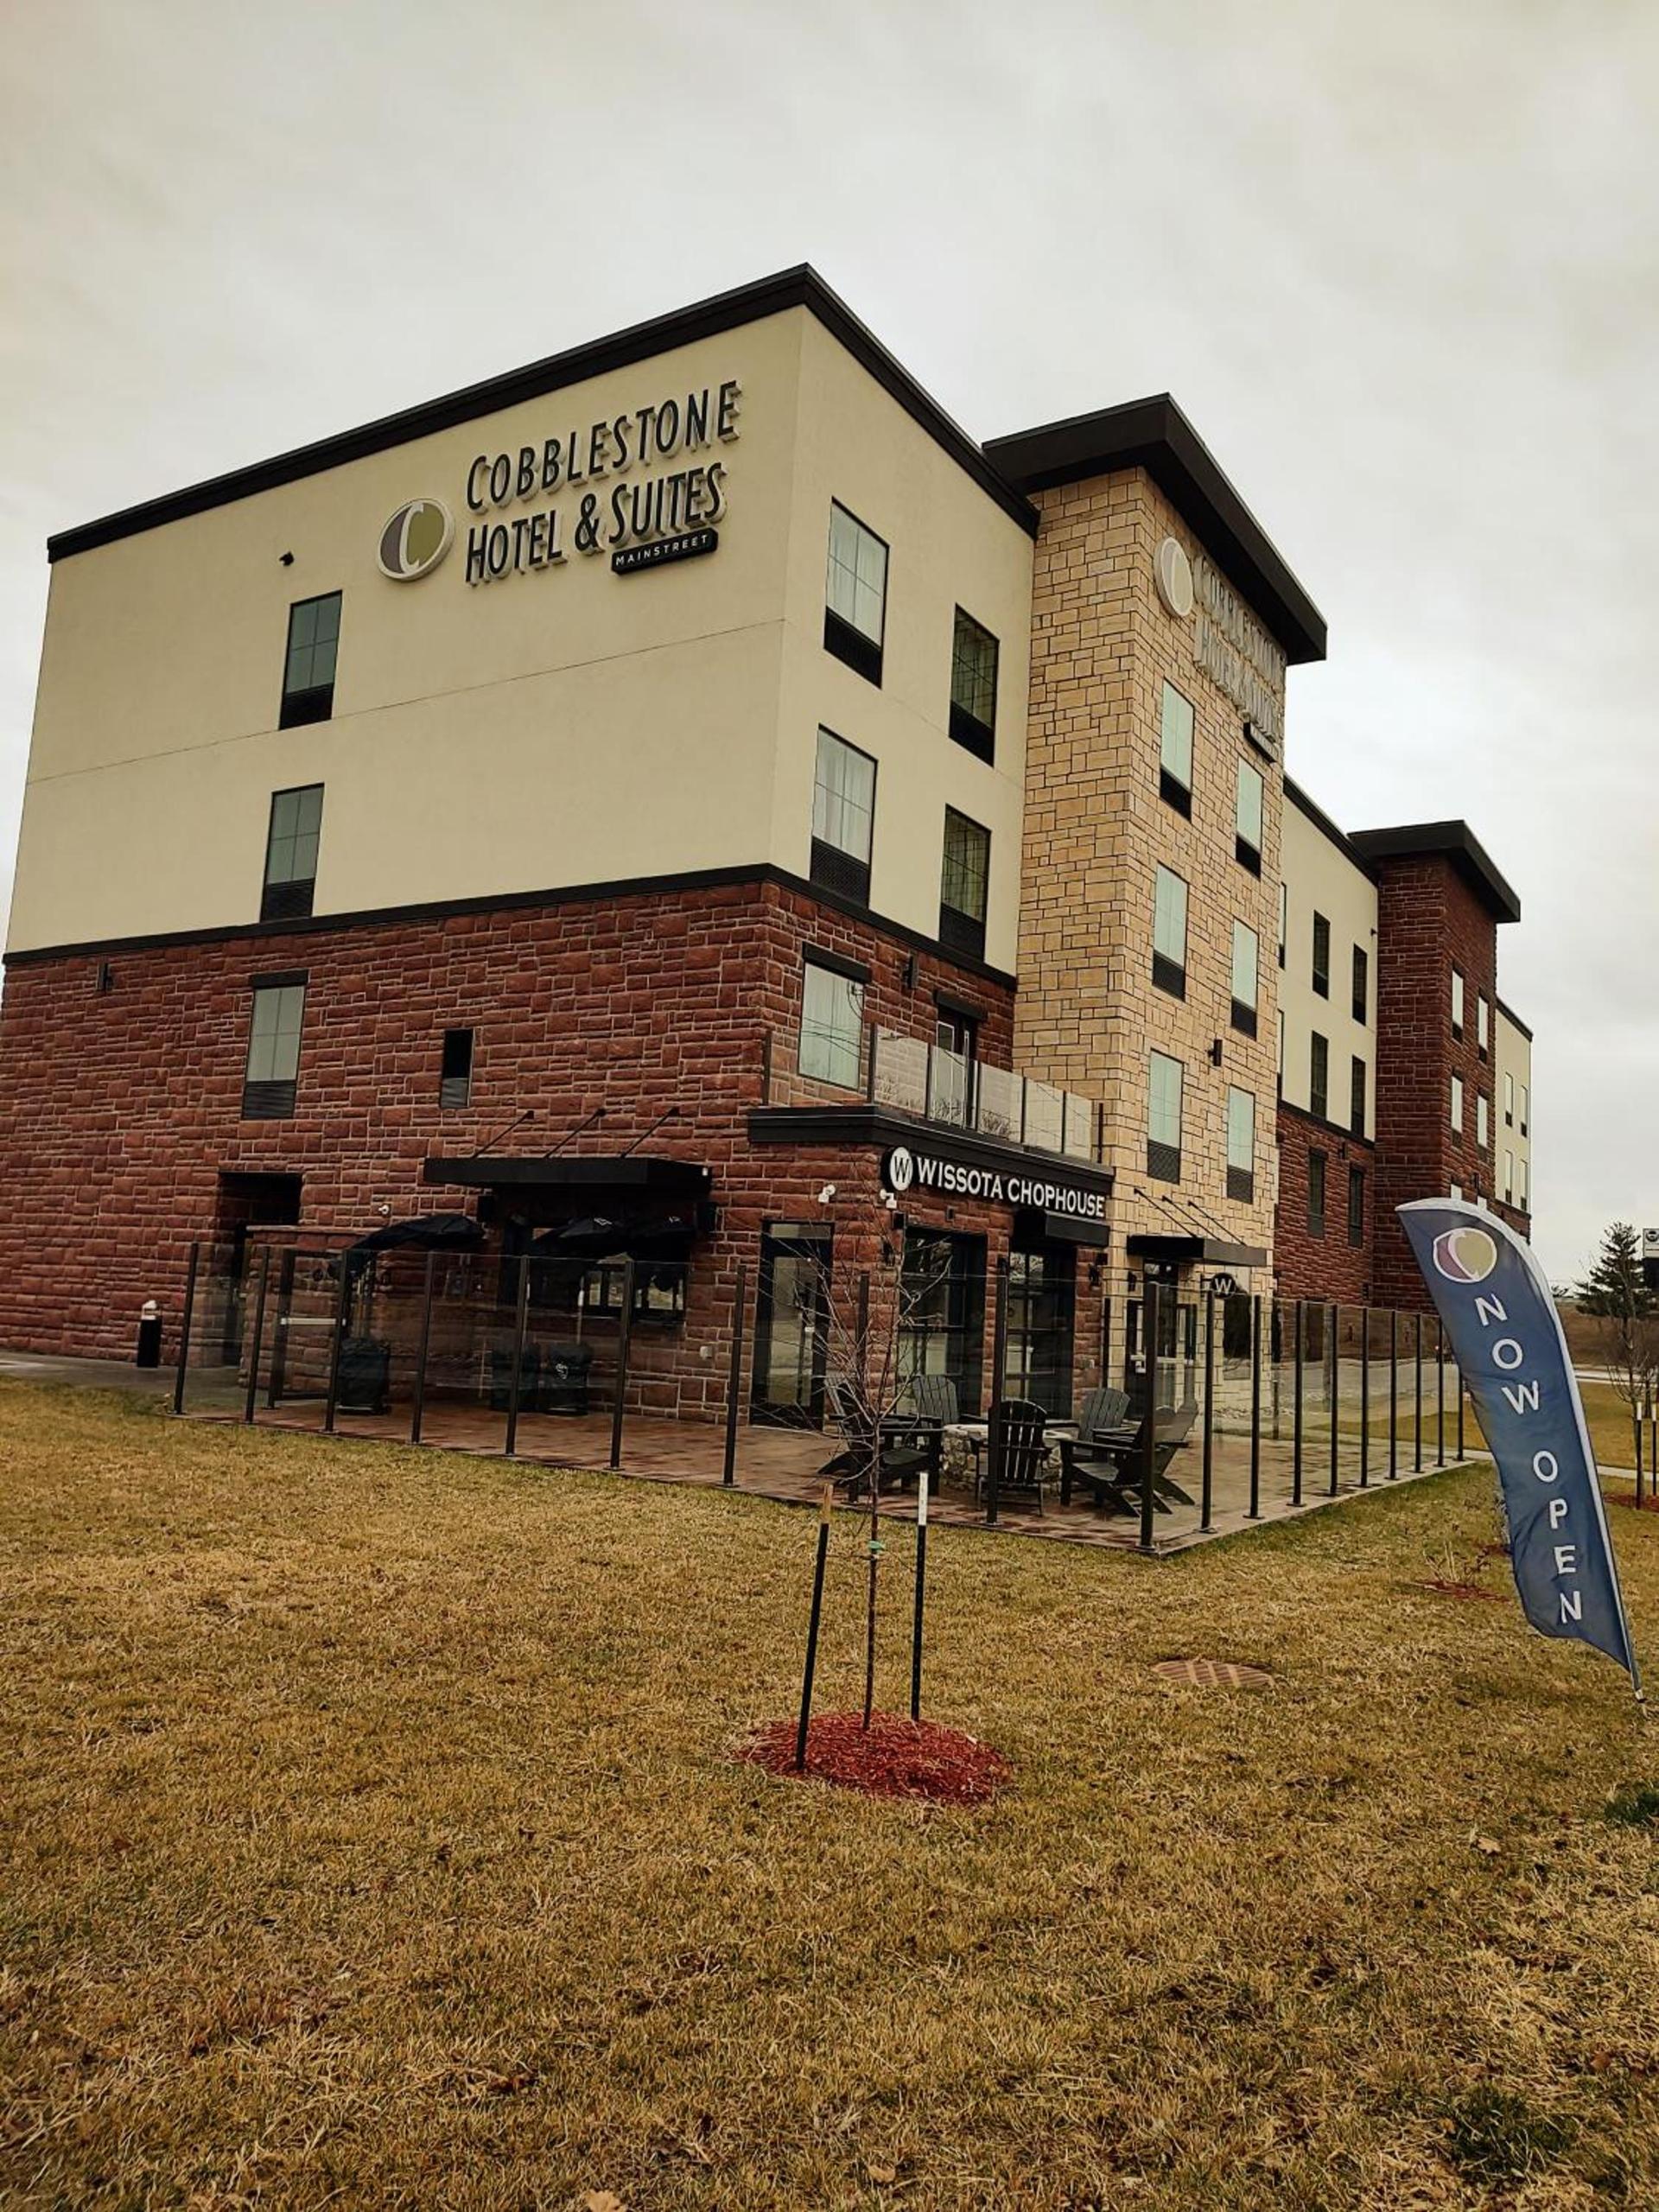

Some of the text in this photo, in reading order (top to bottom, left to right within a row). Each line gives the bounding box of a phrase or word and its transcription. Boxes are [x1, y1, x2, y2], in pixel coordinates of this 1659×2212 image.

[467, 380, 741, 513] COBBLESTONE
[466, 462, 726, 585] HOTEL & SUITES
[615, 534, 708, 566] MAINSTREET
[893, 1154, 1105, 1217] W WISSOTA CHOPHOUSE
[1214, 1278, 1232, 1295] W
[1475, 1294, 1582, 1624] NOW OPEN
